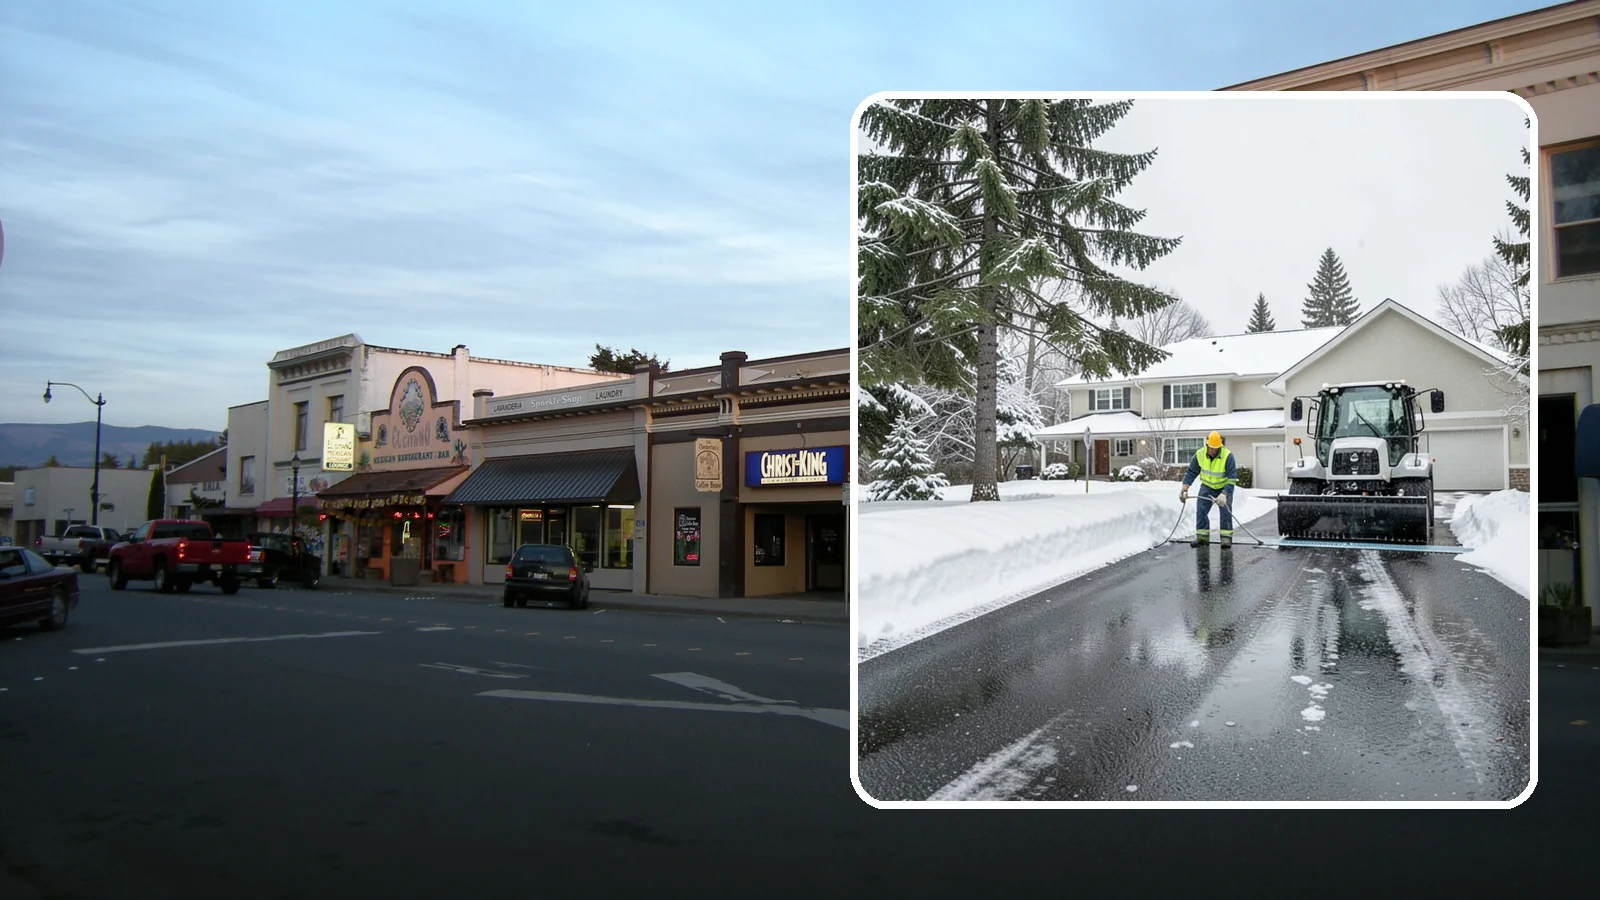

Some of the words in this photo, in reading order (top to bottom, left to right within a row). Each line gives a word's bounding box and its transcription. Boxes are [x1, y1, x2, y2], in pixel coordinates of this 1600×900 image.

[493, 402, 523, 413] LAVANDERIA
[530, 397, 561, 409] Sparkle
[561, 394, 583, 405] Shop
[595, 389, 624, 400] LAUNDRY
[373, 454, 396, 464] MEXICAN
[397, 451, 434, 462] RESTAURANT
[437, 450, 450, 459] BAR
[760, 452, 797, 478] CHRIST
[799, 450, 828, 476] KING
